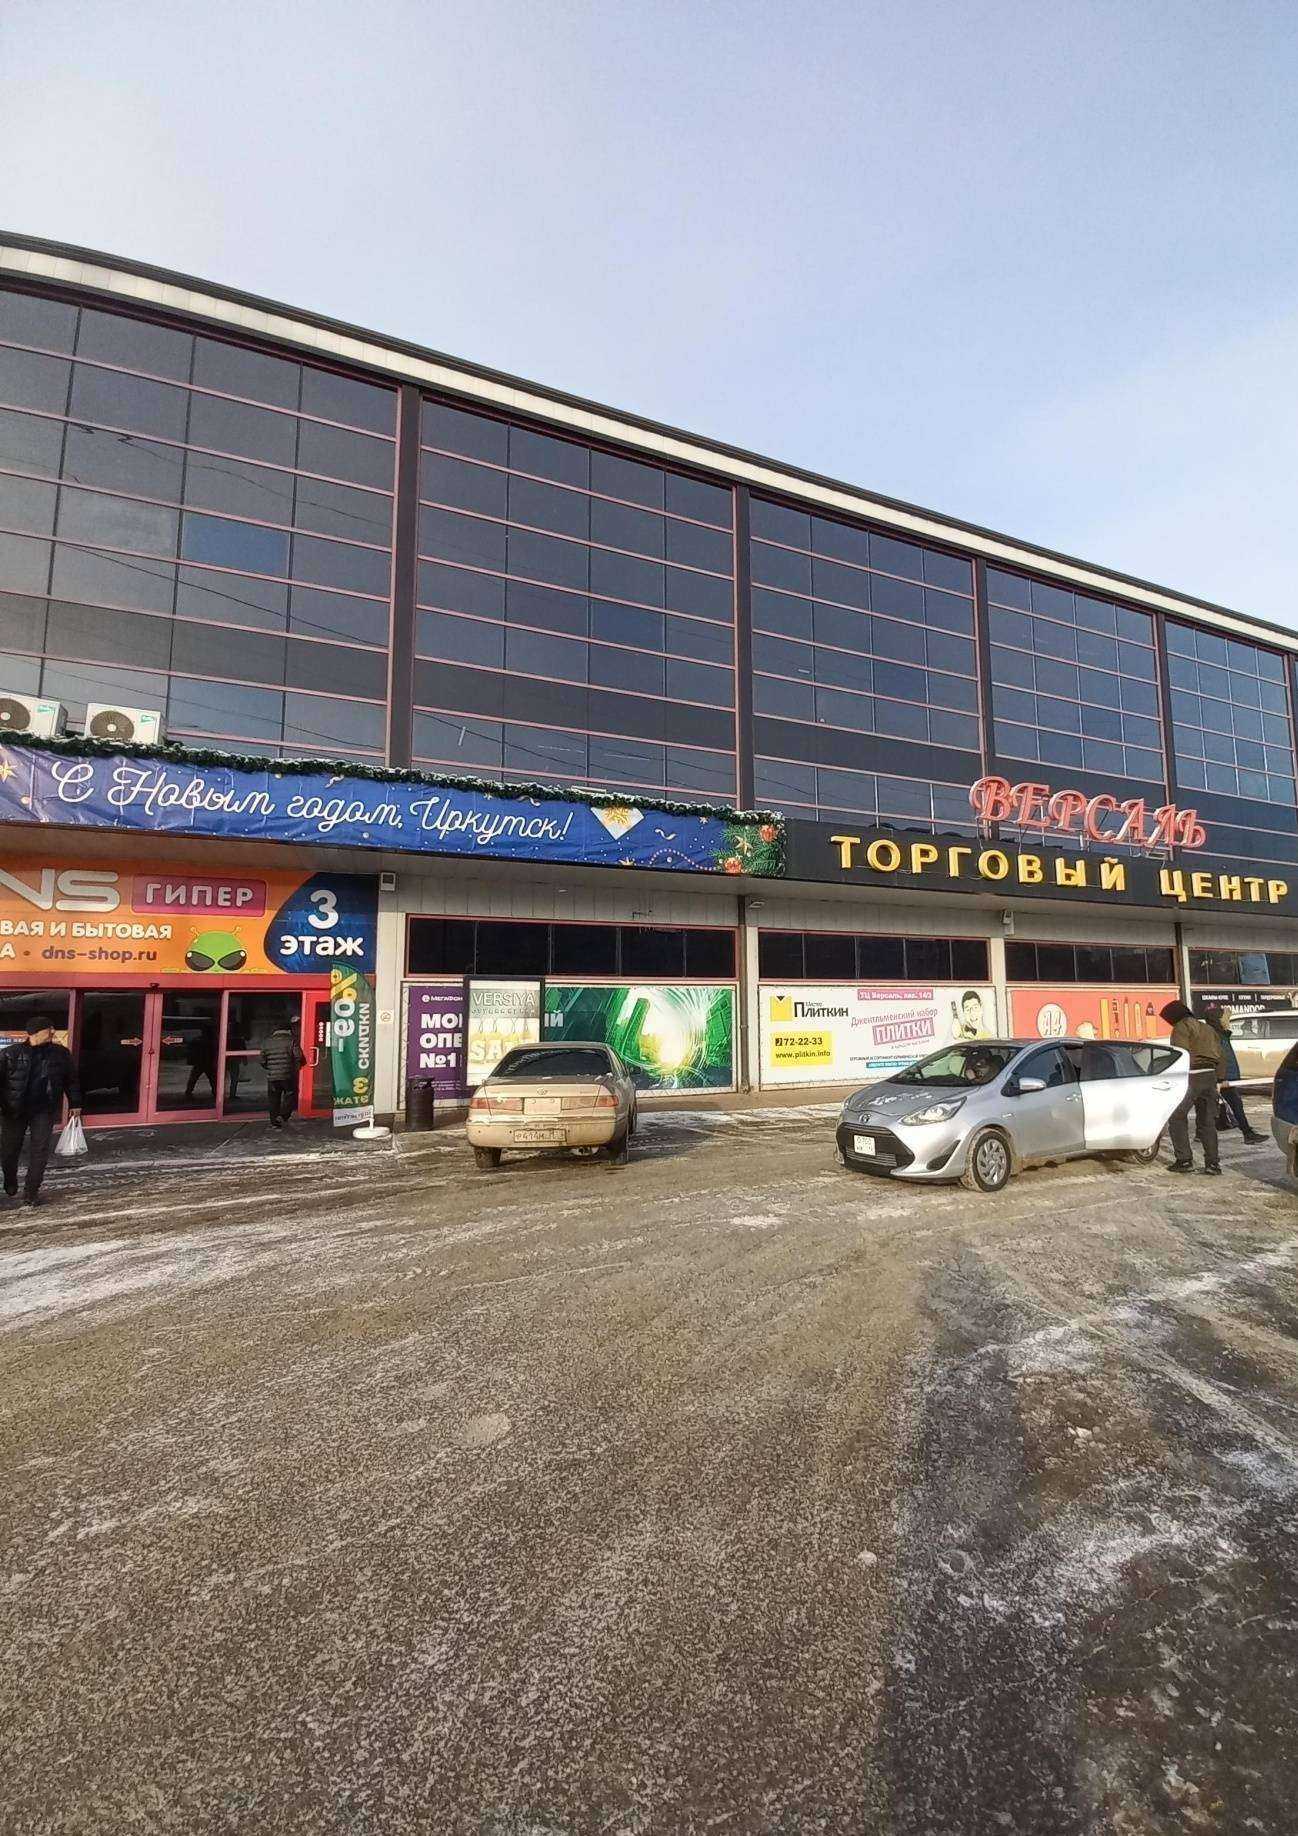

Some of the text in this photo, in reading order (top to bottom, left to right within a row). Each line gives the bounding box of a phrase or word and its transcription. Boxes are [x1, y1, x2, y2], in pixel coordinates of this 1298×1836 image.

[51, 761, 573, 845] С Новым годом, Иркутск!
[968, 775, 1207, 850] ВЕРСАЛЬ
[830, 835, 1289, 904] ТОРГОВЫЙ ЦЕНТР
[145, 883, 254, 908] ГИПЕР
[307, 889, 340, 930] 3
[50, 921, 66, 938] И
[72, 921, 173, 940] БЫТОВАЯ
[42, 945, 157, 963] dns-shop.ru
[280, 934, 365, 957] этаж
[472, 991, 536, 1008] VERSIYA
[794, 1001, 849, 1018] Плиткин
[783, 1037, 823, 1046] 72-22-33
[876, 1019, 932, 1043] ПЛИТКИ
[419, 1052, 457, 1069] №1
[775, 1050, 831, 1059] www.plitkin.info
